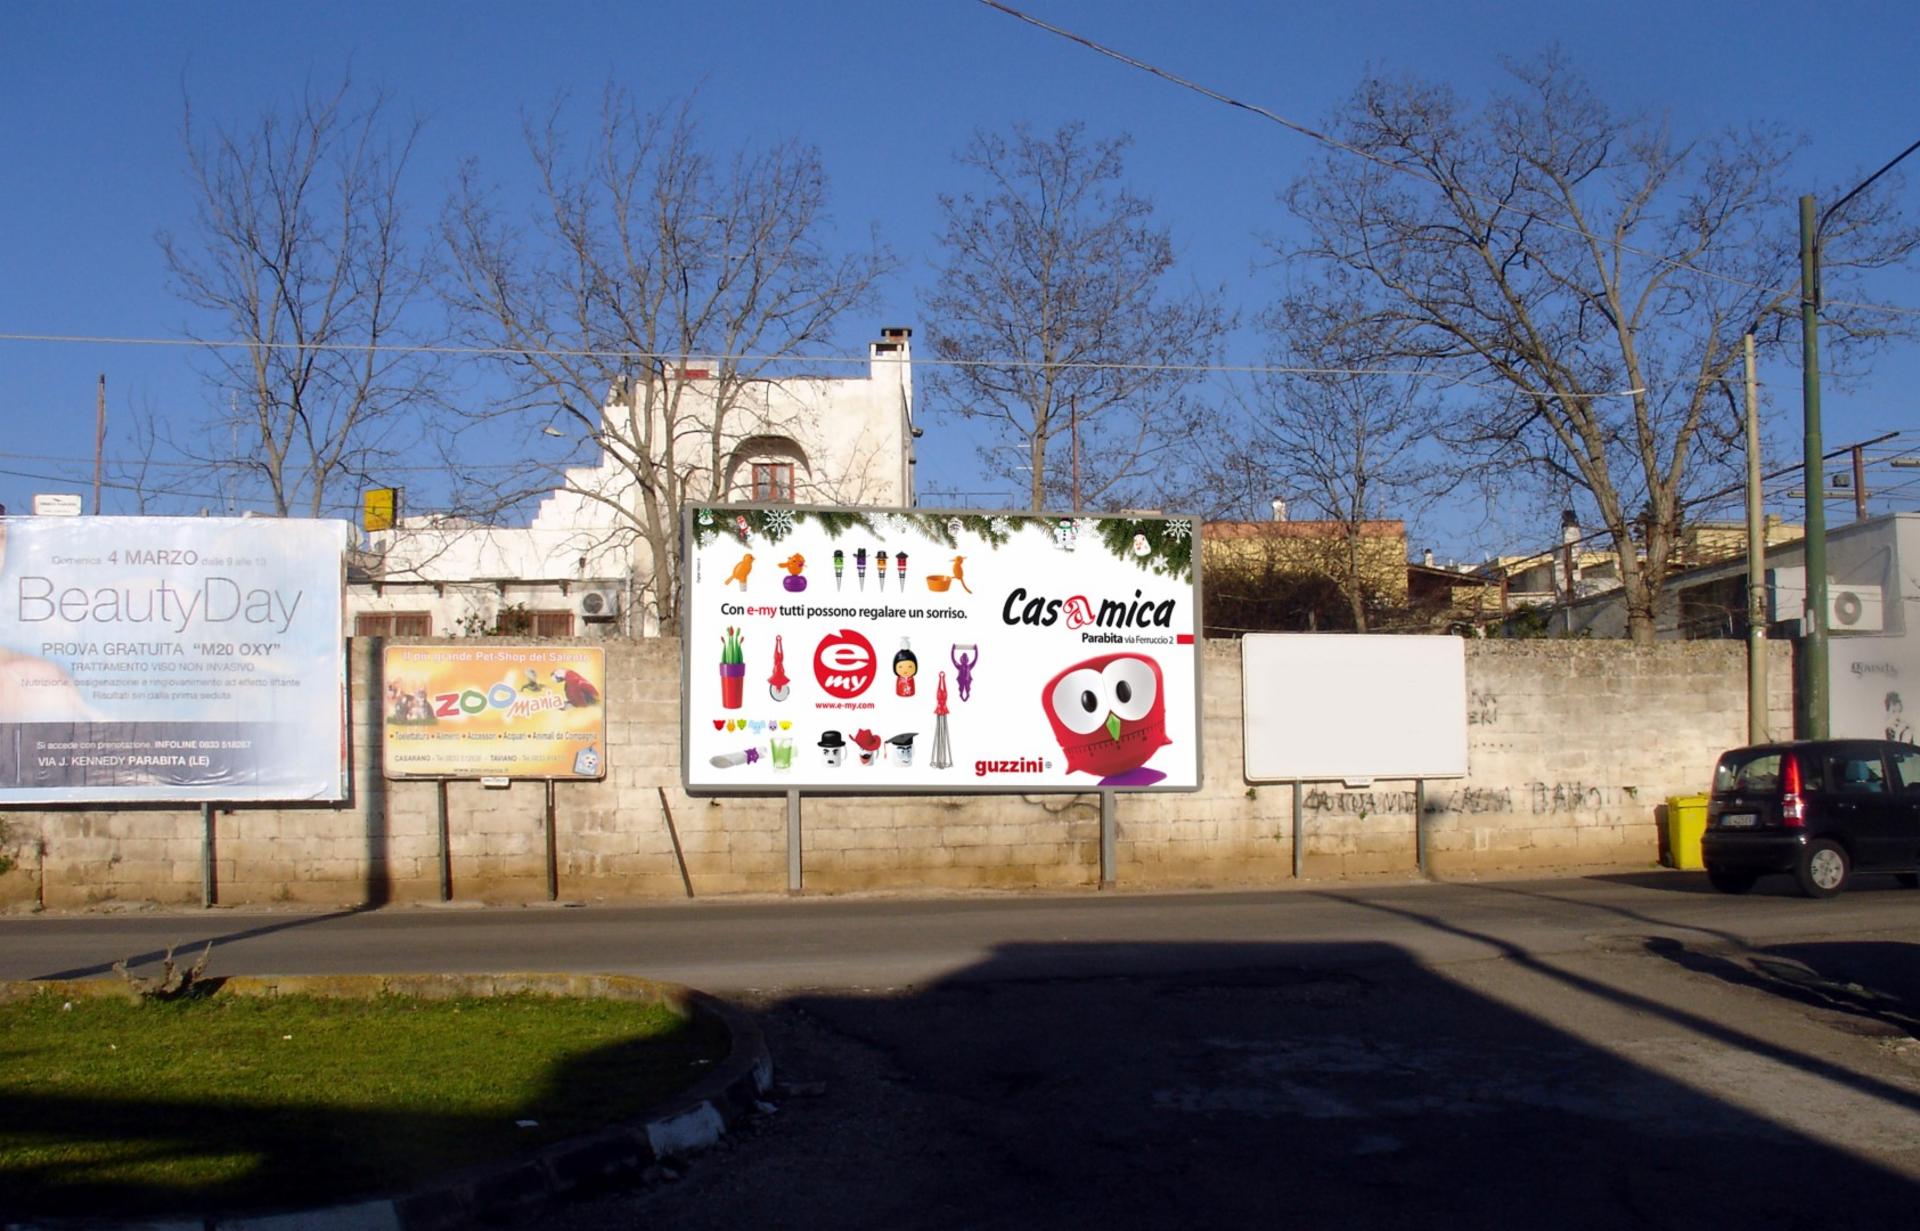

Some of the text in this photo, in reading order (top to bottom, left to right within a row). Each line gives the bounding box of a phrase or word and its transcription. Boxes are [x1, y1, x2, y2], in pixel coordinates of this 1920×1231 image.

[51, 554, 101, 565] Domenica
[108, 550, 118, 564] 4
[125, 549, 198, 565] MARZO
[18, 576, 303, 634] BeautyDay
[721, 603, 967, 620] Con e-my tutti possono regalare un sorriso.
[1081, 632, 1174, 645] Parabita via Ferruccio 2
[41, 642, 98, 656] PROVA
[103, 642, 184, 656] GRATUITA
[476, 651, 526, 663] Pet-Shop
[529, 652, 546, 661] del
[71, 662, 255, 672] TRATTAMENTO VISO NON INVASIVO
[825, 675, 868, 692] my
[815, 702, 875, 711] www.e-my.com
[37, 742, 46, 750] Si
[80, 742, 97, 750] con
[155, 741, 198, 749] INFOLINE
[38, 757, 56, 767] VIA
[71, 756, 126, 766] KENNEDY
[128, 756, 186, 766] PARABITA
[188, 756, 210, 767] (LE)
[394, 754, 431, 762] CASARANO
